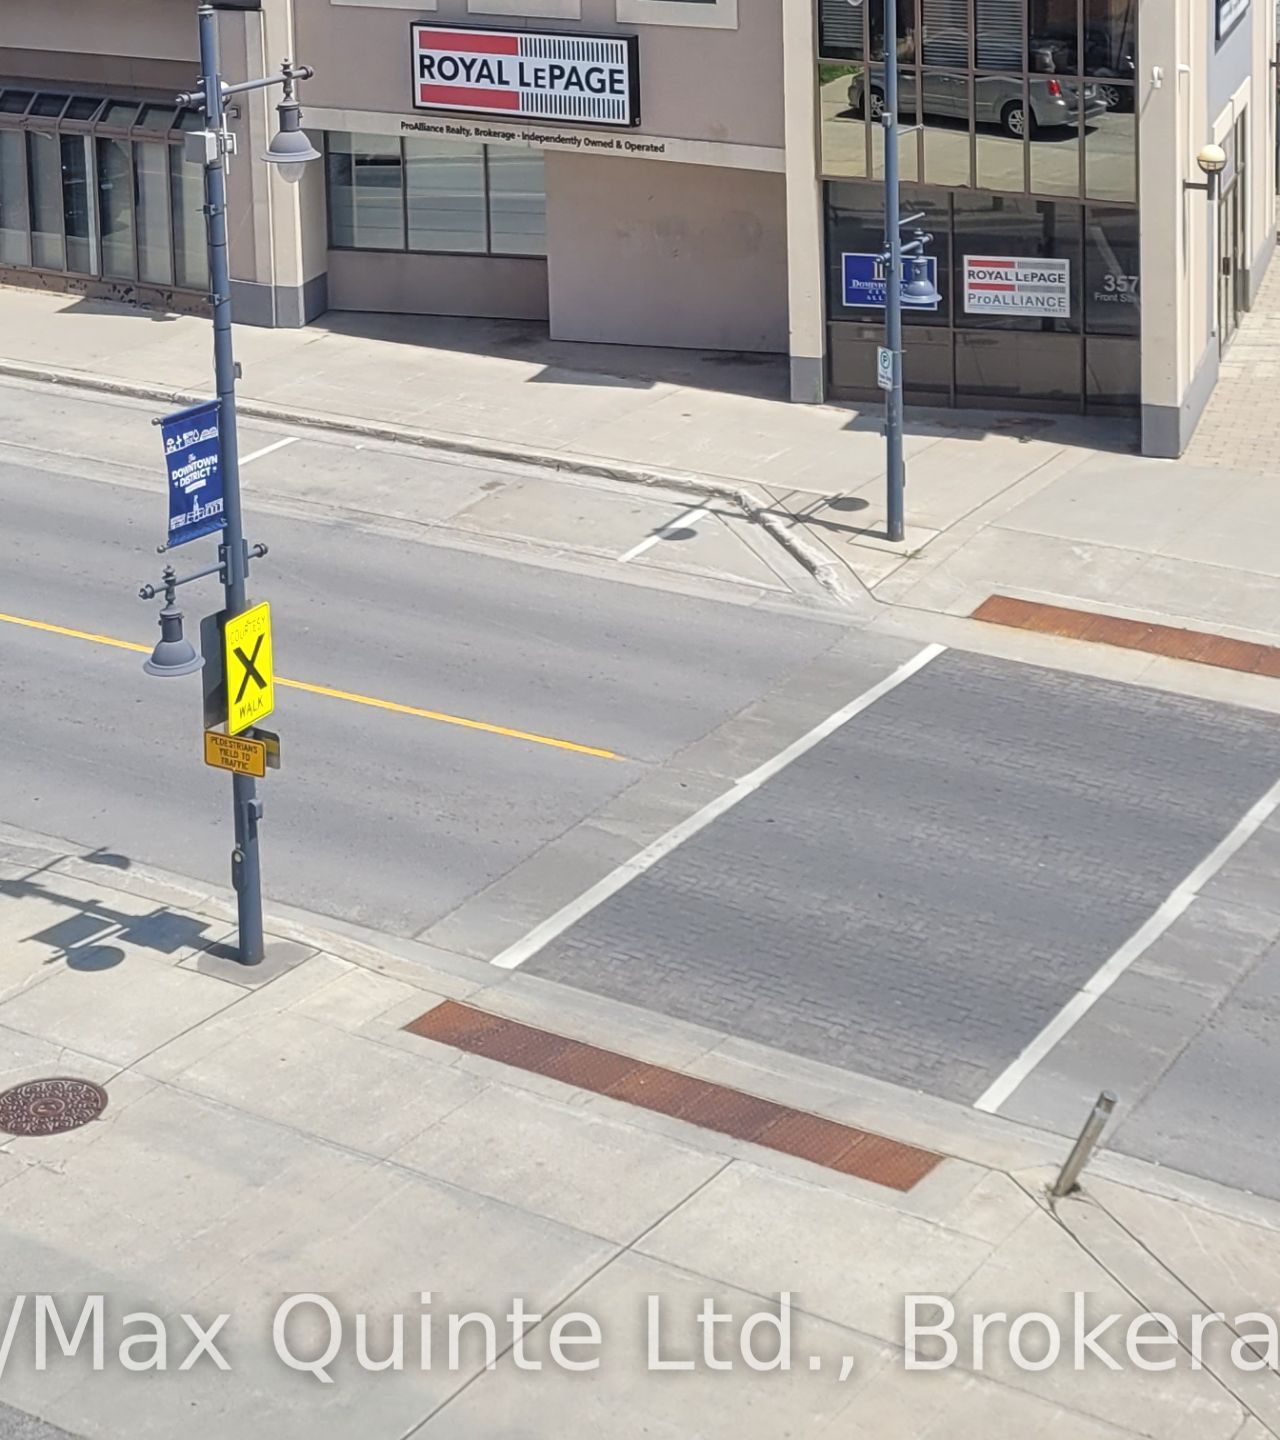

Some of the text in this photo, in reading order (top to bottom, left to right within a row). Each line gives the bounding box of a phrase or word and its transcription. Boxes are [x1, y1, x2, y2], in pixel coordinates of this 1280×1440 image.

[419, 54, 510, 86] ROYAL
[400, 121, 444, 134] ProAlliance
[445, 125, 472, 138] Realty,
[474, 127, 516, 141] Brokerage
[521, 131, 582, 148] Independently
[583, 137, 614, 149] Owned
[615, 140, 623, 149] &
[624, 141, 665, 153] Operated
[967, 269, 1013, 282] ROYAL
[1104, 274, 1139, 292] 357
[967, 293, 1066, 308] ProALLIANCE
[171, 454, 218, 481] DOWNTOWN
[180, 467, 211, 488] DISTRICT
[230, 615, 266, 645] COURTESY
[239, 695, 264, 720] WALK
[210, 736, 258, 754] PEDESTRIANS
[218, 747, 251, 762] YIELD TO
[220, 757, 249, 771] TRAFFIC
